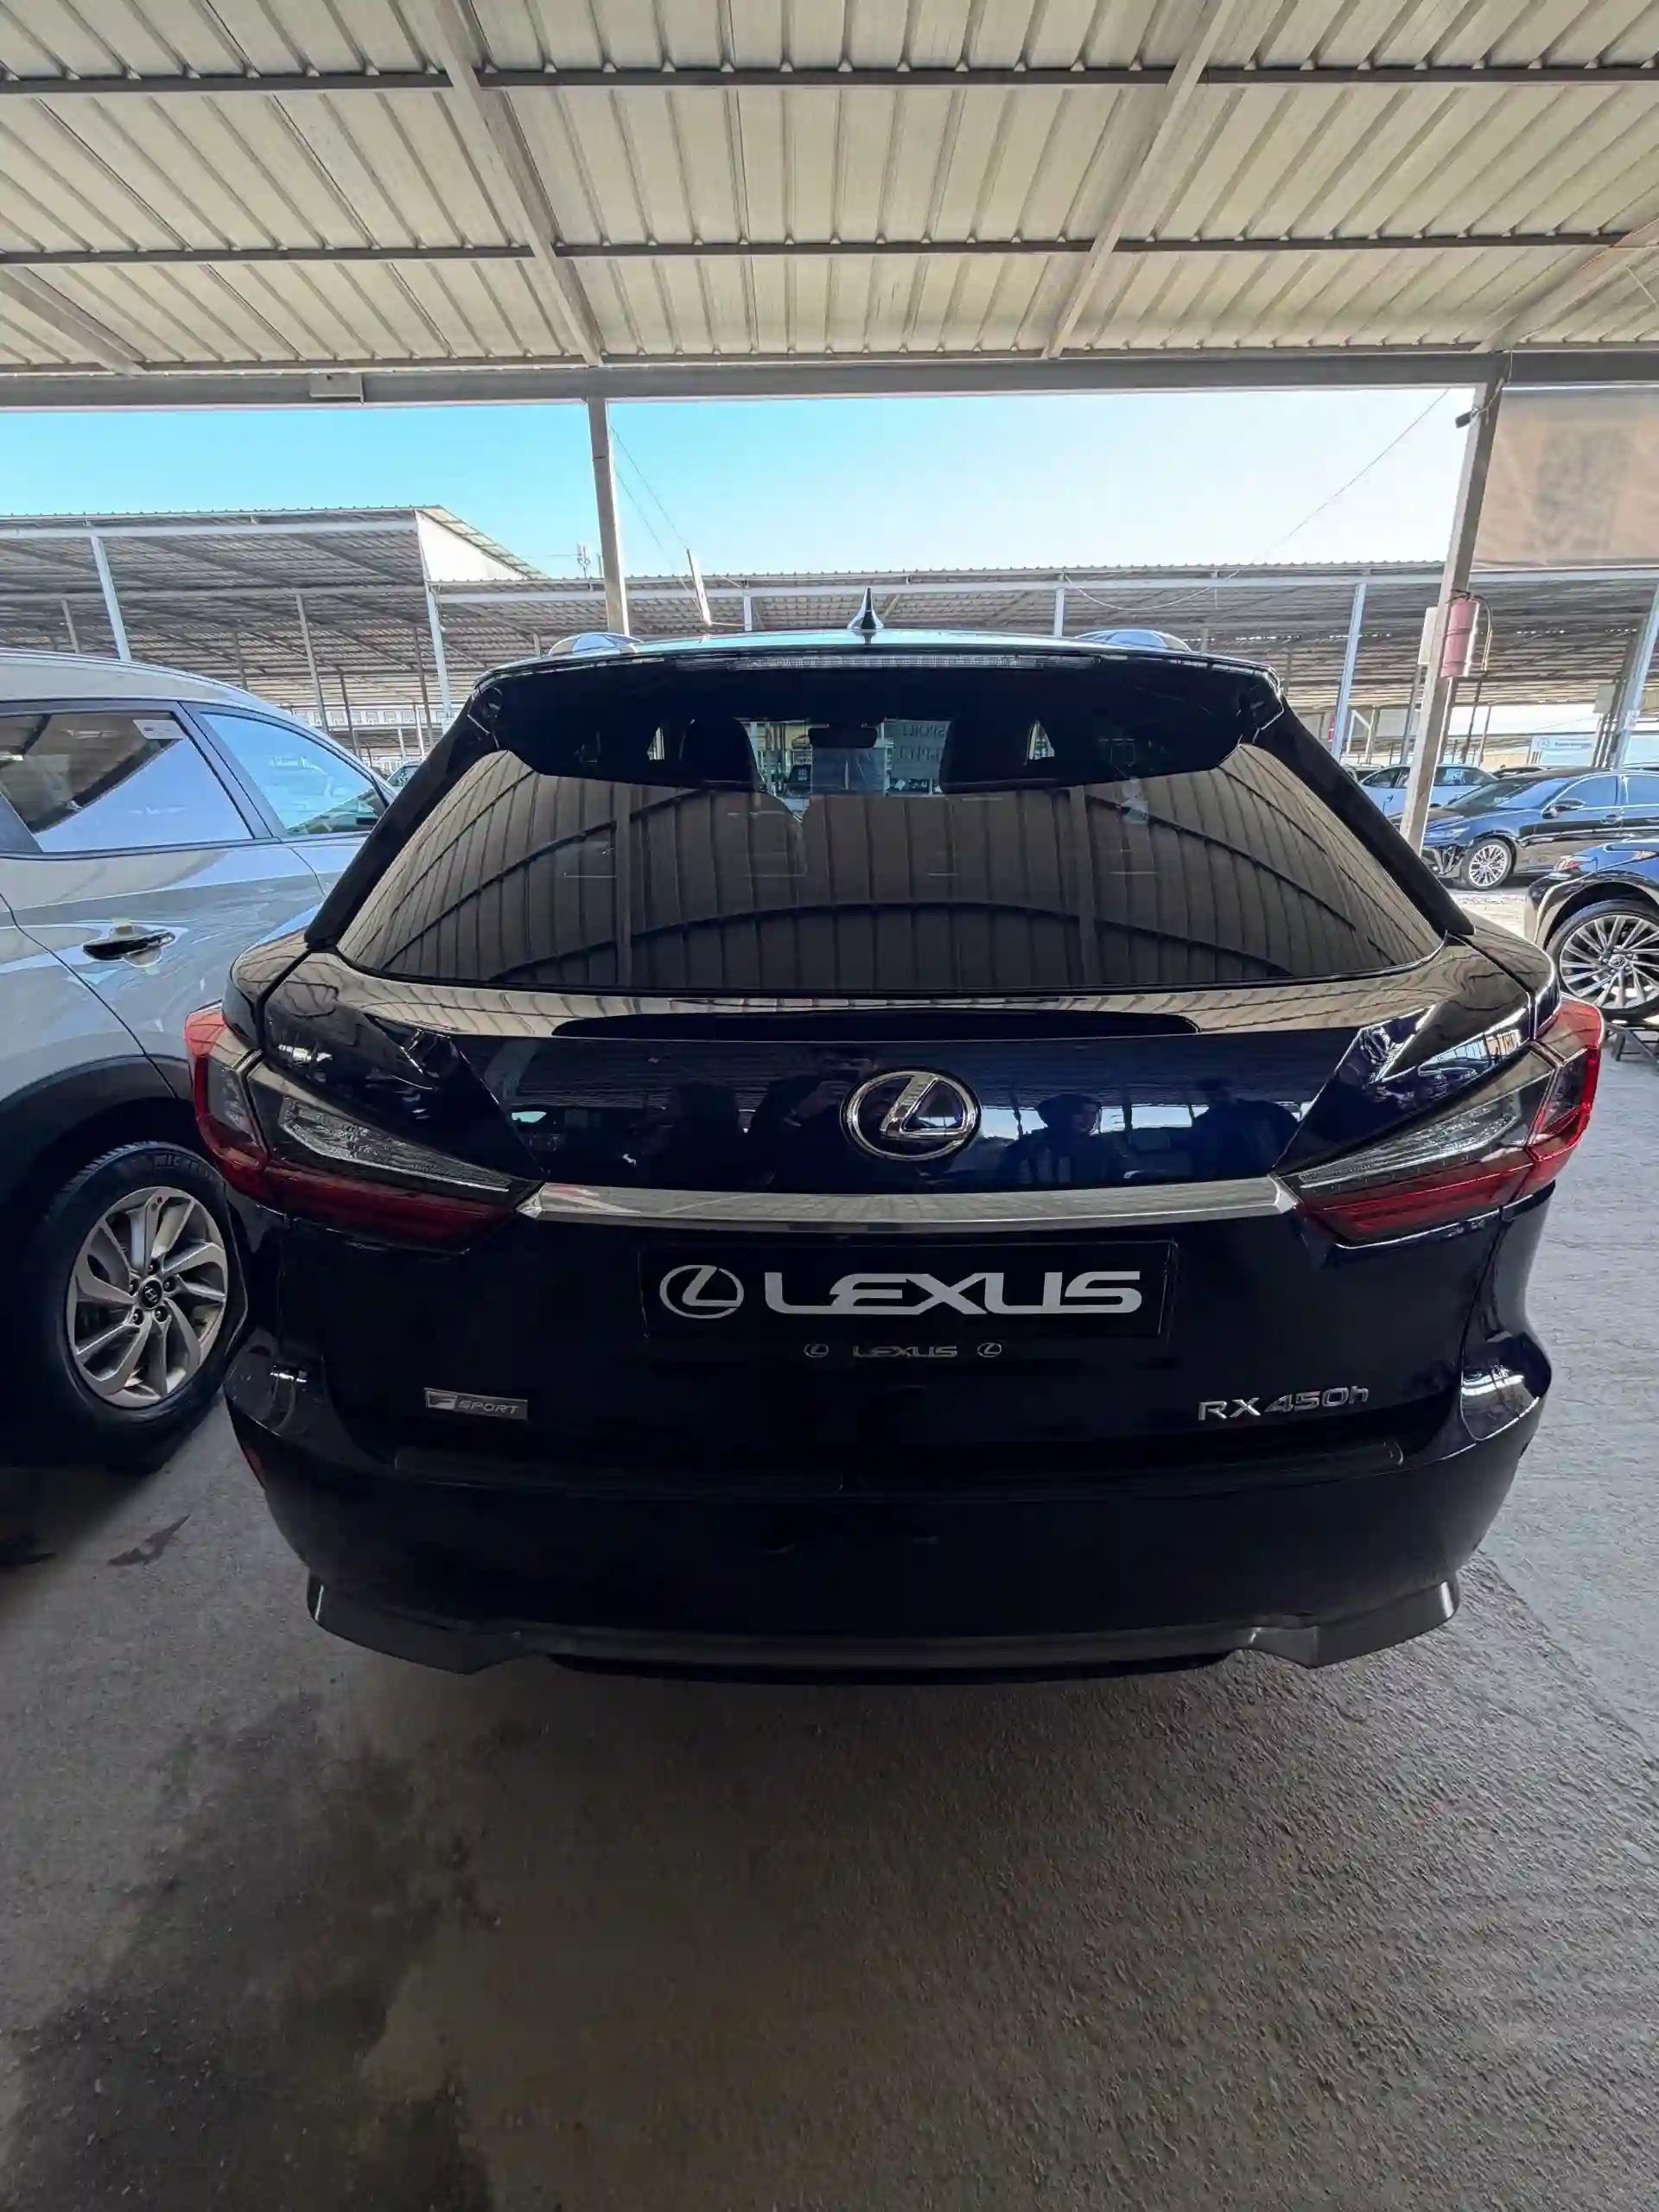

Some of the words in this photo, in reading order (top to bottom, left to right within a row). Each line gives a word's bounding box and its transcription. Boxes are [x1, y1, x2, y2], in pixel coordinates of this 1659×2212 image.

[764, 1271, 1141, 1314] LEXUS
[853, 1345, 957, 1357] LEXUS
[458, 1400, 519, 1414] SPORT
[1198, 1397, 1261, 1421] RX
[1264, 1386, 1369, 1413] 450h
